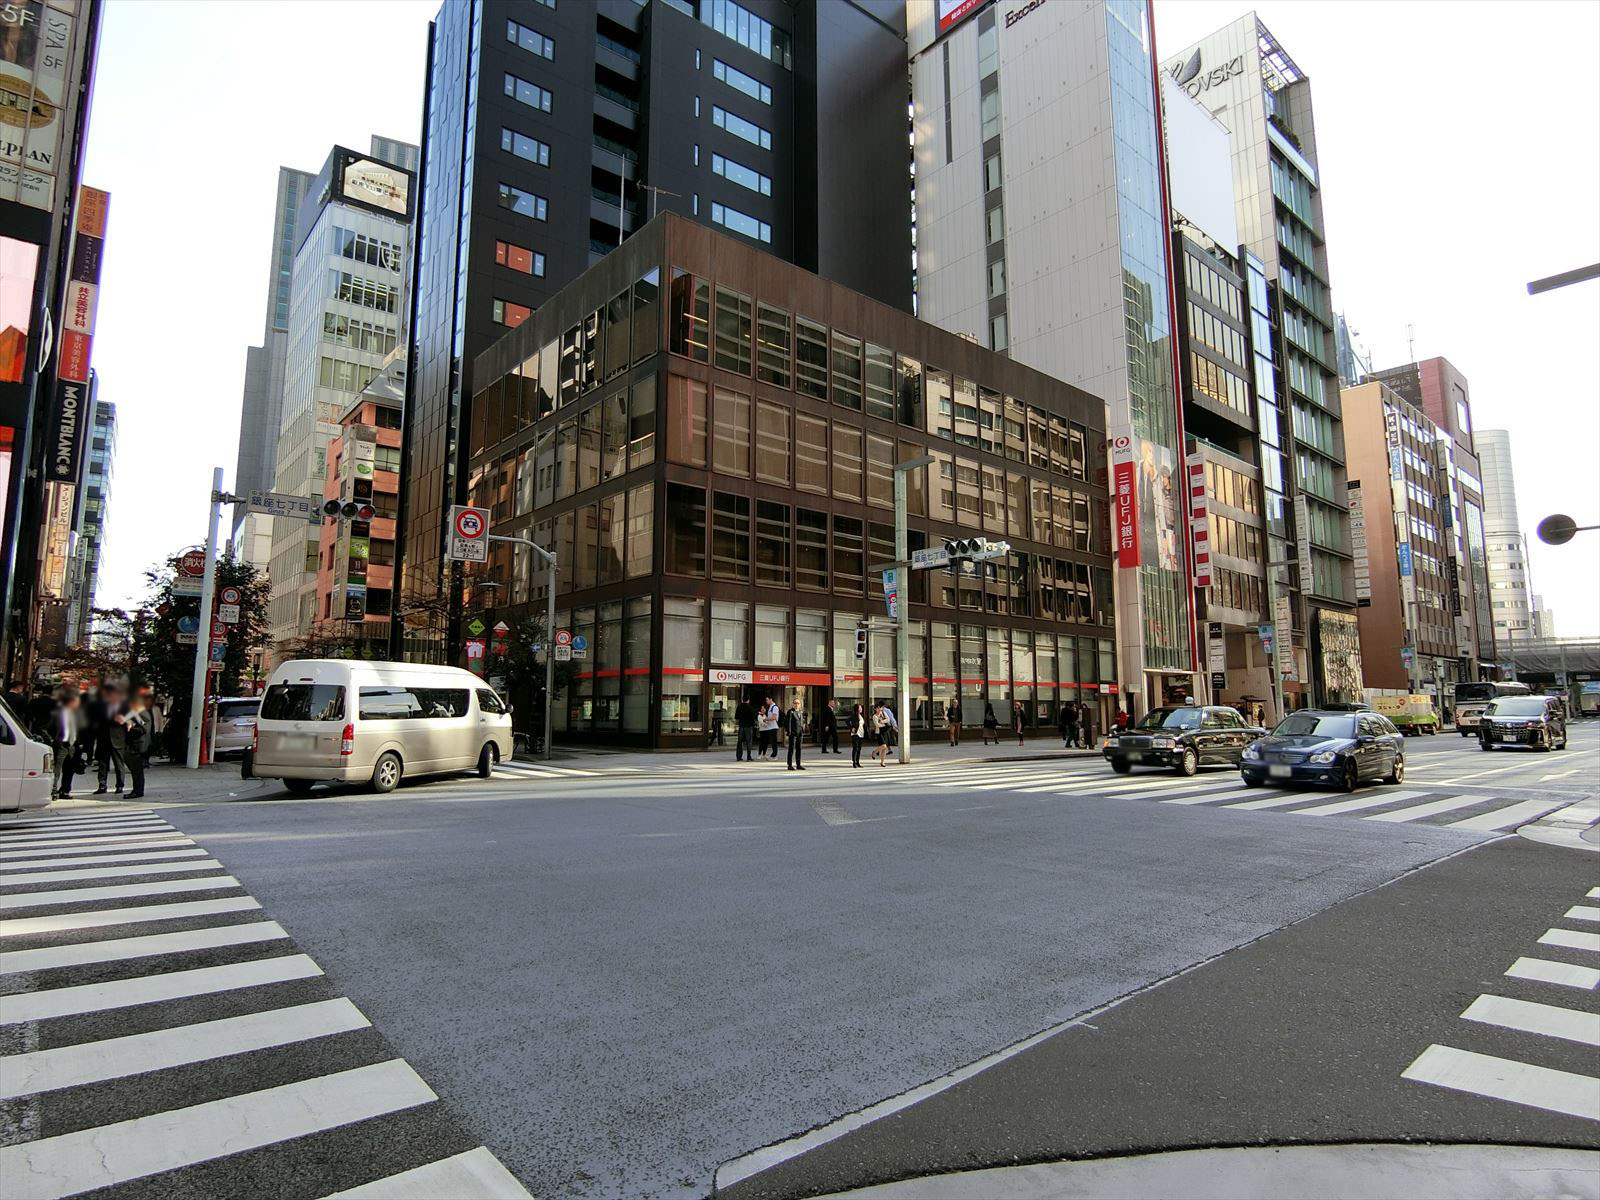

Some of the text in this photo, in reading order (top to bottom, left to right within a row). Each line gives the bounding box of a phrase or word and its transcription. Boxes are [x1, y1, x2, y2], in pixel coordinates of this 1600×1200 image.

[1, 3, 35, 26] 5F
[45, 18, 67, 49] SPA
[43, 55, 63, 69] 5F
[1184, 55, 1244, 99] OVSKI
[56, 385, 80, 465] MONTBLANC
[251, 496, 309, 512] 銀座七丁目
[1119, 471, 1133, 549] 三菱UFJ銀行
[914, 551, 947, 562] 銀座七丁目
[213, 624, 224, 633] 30
[759, 674, 790, 682] 三菱UFJ銀行
